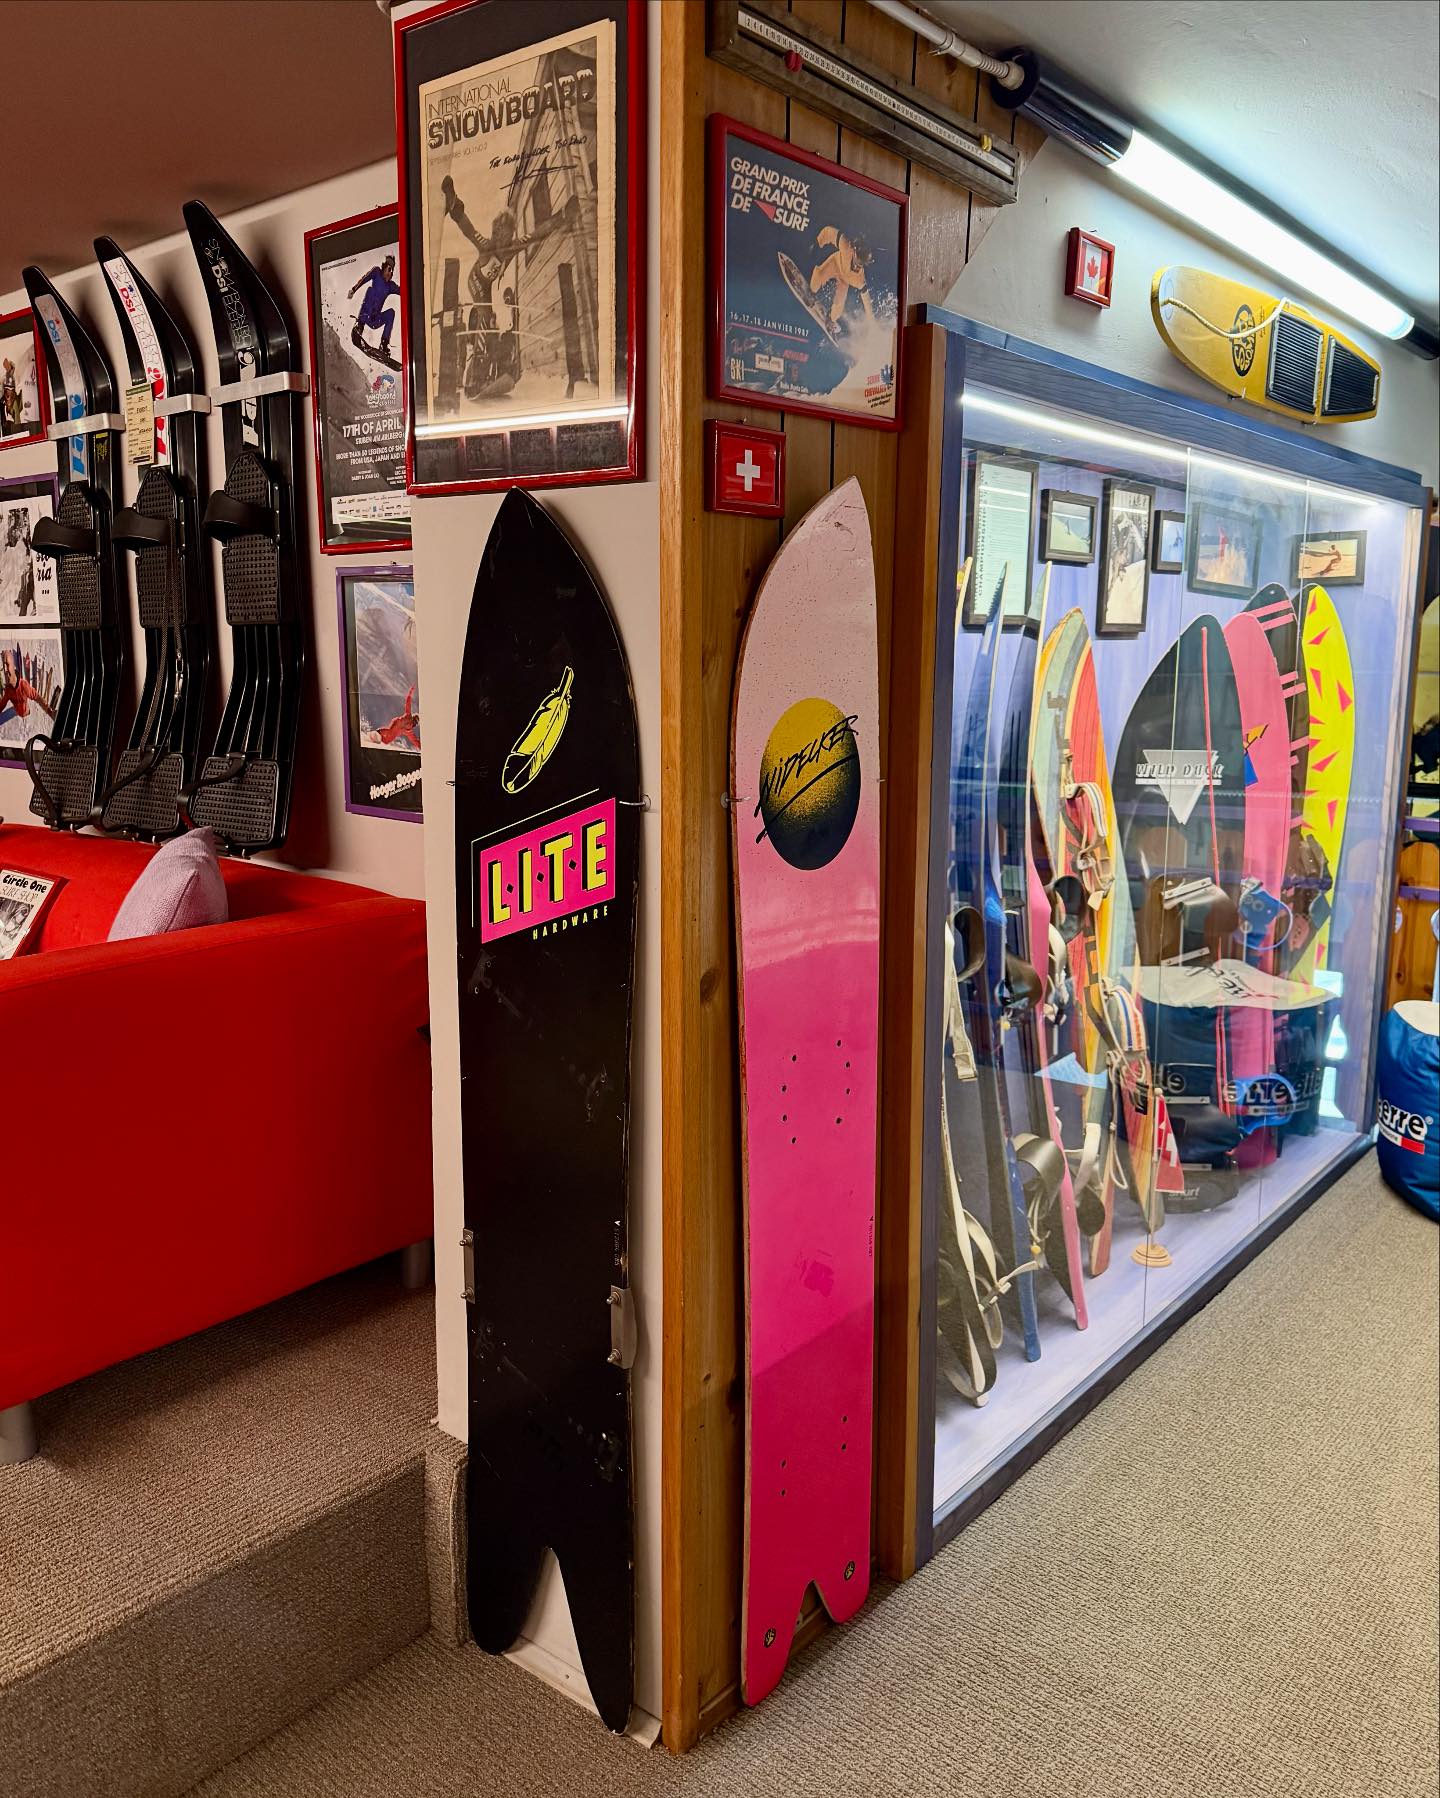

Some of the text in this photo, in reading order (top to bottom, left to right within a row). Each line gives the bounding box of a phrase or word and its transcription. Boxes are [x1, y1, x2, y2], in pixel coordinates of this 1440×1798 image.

[427, 68, 594, 149] SNOWBOARD
[428, 76, 511, 117] INTERNATIONAL
[731, 156, 810, 198] GRAND PRIX
[731, 173, 810, 215] DE FRANCE
[730, 192, 810, 232] DE SURF
[211, 264, 229, 293] DSI
[119, 287, 136, 313] DSI
[47, 319, 61, 344] DSI
[763, 319, 793, 334] JANVIER
[342, 416, 402, 438] 17TH OF APRIL
[335, 452, 349, 461] MORE
[349, 450, 361, 459] THAN
[368, 446, 388, 456] LEGENDS
[350, 457, 364, 466] FROM
[375, 453, 390, 462] JAPAN
[390, 452, 401, 460] AND
[1135, 763, 1177, 778] WILD
[370, 779, 397, 800] Hooger
[3, 874, 47, 894] Circle One
[531, 905, 609, 941] HARDWARE
